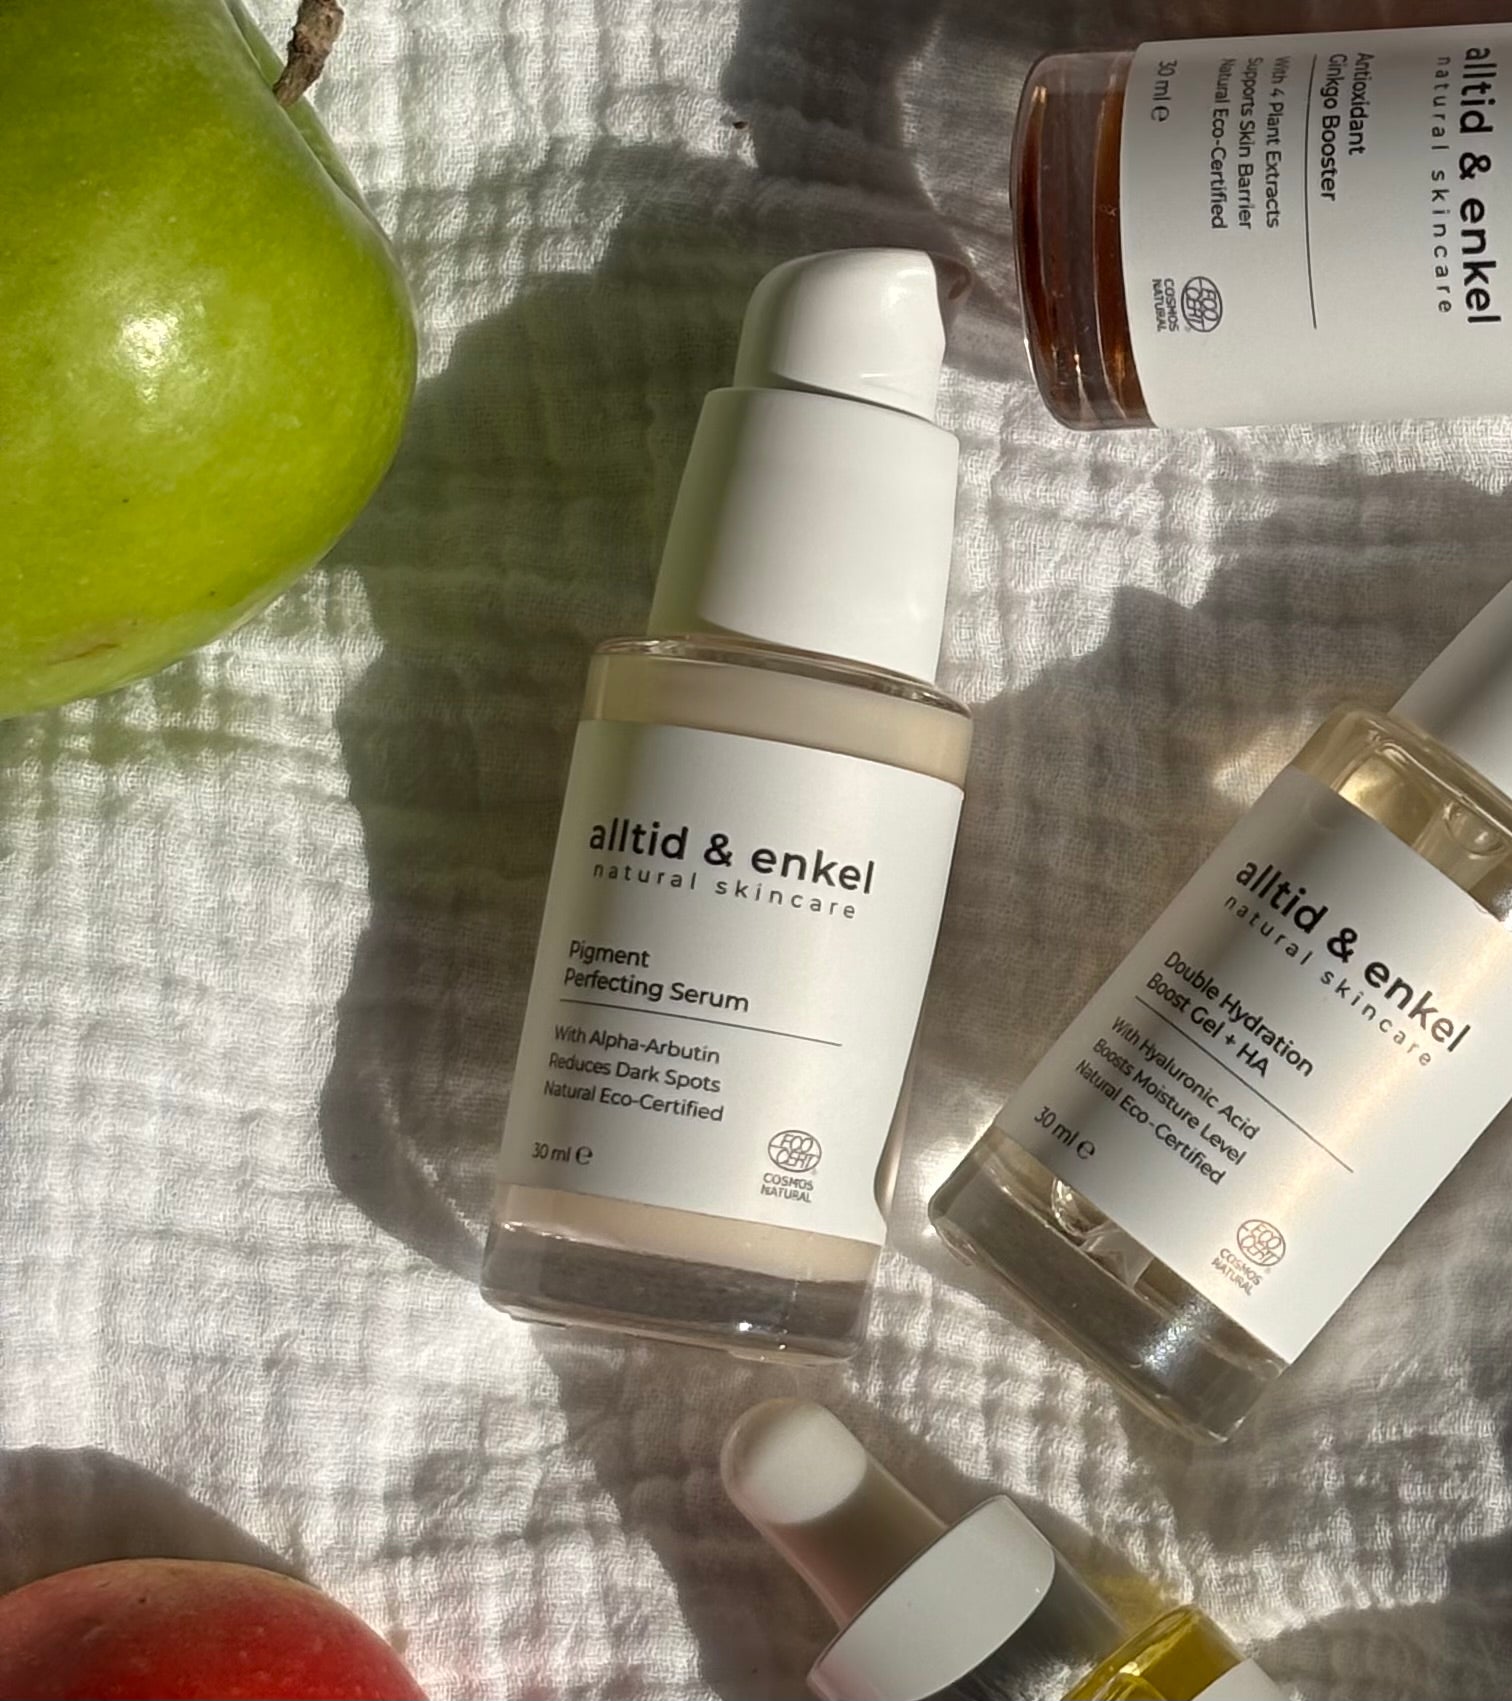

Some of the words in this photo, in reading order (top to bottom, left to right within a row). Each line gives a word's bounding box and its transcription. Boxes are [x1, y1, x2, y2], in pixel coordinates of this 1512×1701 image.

[1153, 80, 1172, 102] ml
[1158, 59, 1176, 77] 30
[1213, 57, 1236, 104] Natural
[1241, 56, 1263, 115] Supports
[1269, 88, 1285, 97] 4
[1270, 55, 1291, 84] With
[1320, 53, 1347, 110] Ginkgo
[1459, 47, 1497, 134] alltid
[1266, 101, 1283, 147] Plant
[1348, 51, 1374, 156] Antioxidant
[1430, 55, 1451, 152] natural
[1238, 119, 1257, 158] Skin
[1320, 116, 1342, 202] Booster
[1210, 108, 1228, 230] Eco-Certified
[1265, 150, 1280, 229] Extracts
[1459, 152, 1491, 180] &
[1237, 162, 1253, 230] Barrier
[1430, 171, 1452, 314] skincare
[1459, 198, 1502, 324] enkel
[1152, 278, 1167, 332] NATURAL
[1164, 278, 1179, 332] COSMOS
[589, 817, 689, 861] alltid
[703, 833, 733, 868] &
[751, 849, 875, 895] enkel
[593, 863, 696, 890] natural
[715, 878, 857, 920] skincare
[569, 939, 651, 969] Pigment
[1225, 894, 1312, 966] natural
[1320, 970, 1432, 1067] skincare
[1236, 859, 1329, 934] alltid
[1326, 927, 1358, 963] &
[1364, 960, 1472, 1053] enkel
[564, 967, 664, 1002] Perfecting
[669, 982, 750, 1014] Serum
[1164, 950, 1220, 1001] Double
[1219, 989, 1315, 1077] Hydration
[554, 1024, 587, 1046] With
[589, 1029, 720, 1065] Alpha-Arbutin
[1146, 971, 1191, 1017] Boost
[1190, 1005, 1225, 1040] Gel
[1225, 1033, 1236, 1047] +
[1236, 1042, 1270, 1078] HA
[549, 1052, 611, 1076] Reduces
[615, 1060, 660, 1084] Dark
[664, 1069, 721, 1094] Spots
[1111, 1016, 1141, 1048] With
[1139, 1033, 1220, 1109] Hyaluronic
[1218, 1103, 1261, 1141] Acid
[544, 1079, 596, 1102] Natural
[600, 1087, 724, 1122] Eco-Certified
[1034, 1105, 1056, 1128] 30
[1051, 1121, 1080, 1149] ml
[1075, 1059, 1121, 1104] Natural
[1119, 1093, 1226, 1185] Eco-Certified
[1092, 1037, 1134, 1077] Boosts
[1133, 1066, 1201, 1131] Moisture
[1200, 1124, 1247, 1166] Level
[531, 1141, 550, 1160] 30
[550, 1146, 571, 1163] ml
[760, 1183, 812, 1203] NATURAL
[763, 1172, 814, 1191] COSMOS
[1211, 1257, 1253, 1296] NATURAL
[1220, 1248, 1262, 1285] COSMOS
